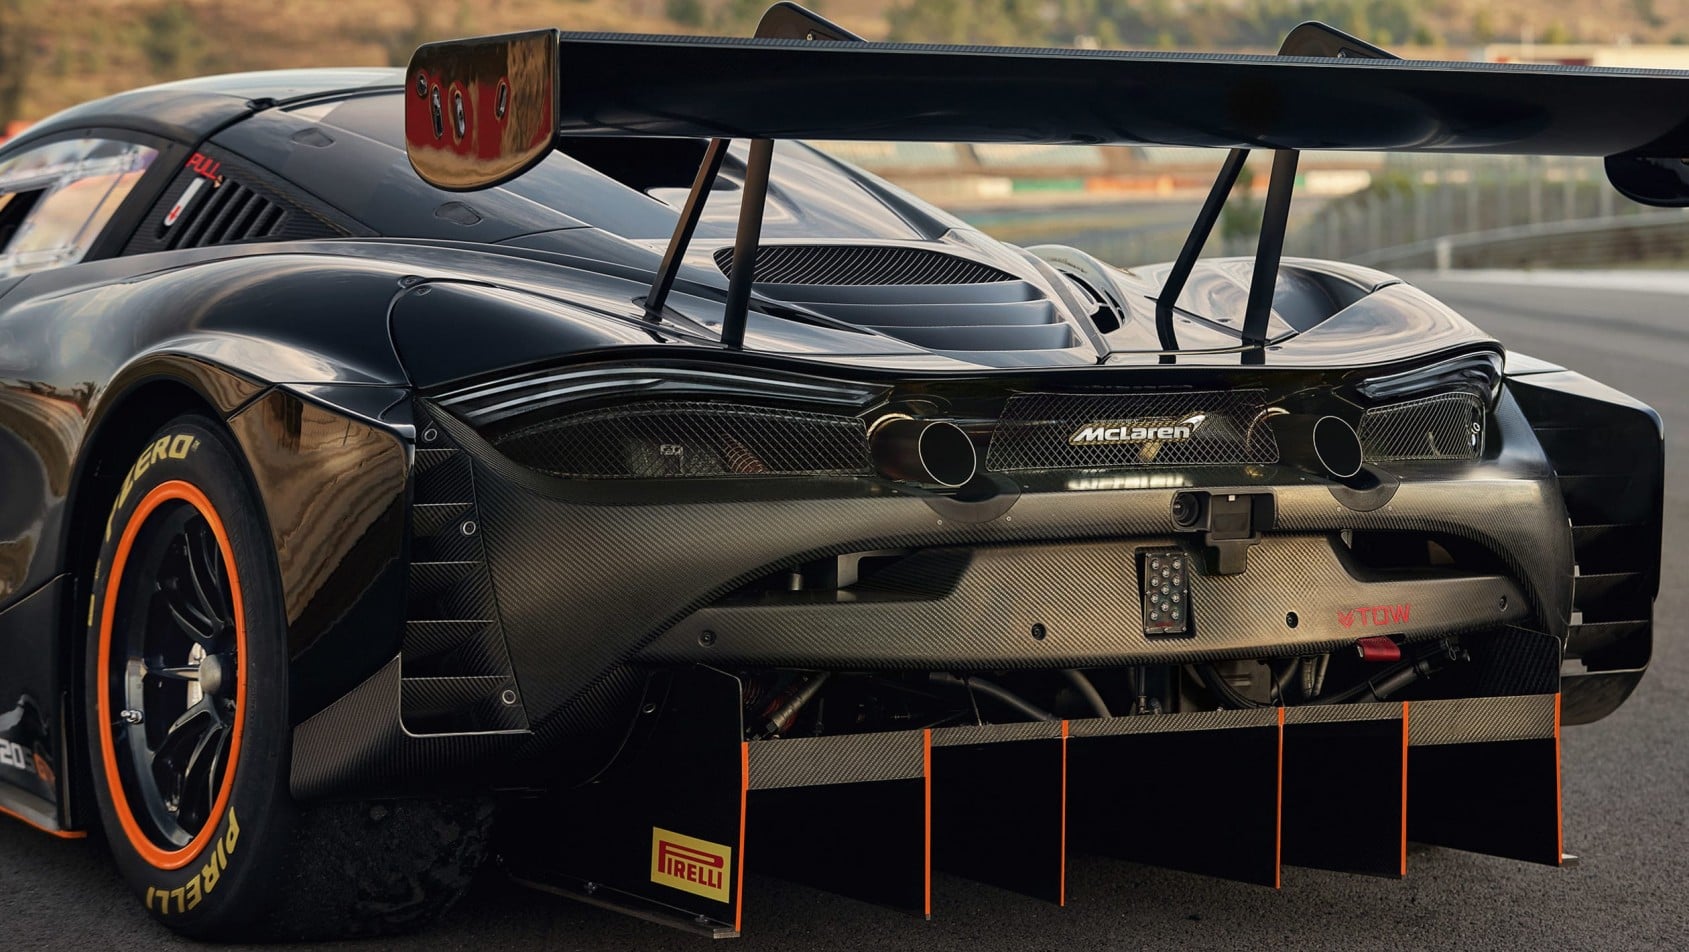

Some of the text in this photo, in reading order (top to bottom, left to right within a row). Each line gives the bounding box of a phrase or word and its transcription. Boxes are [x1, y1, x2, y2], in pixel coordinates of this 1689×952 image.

[185, 152, 220, 180] PULL
[1072, 425, 1191, 442] McLaren
[1355, 603, 1410, 626] TOW
[146, 806, 240, 915] PIRELLI
[658, 839, 724, 890] PIRELLI
